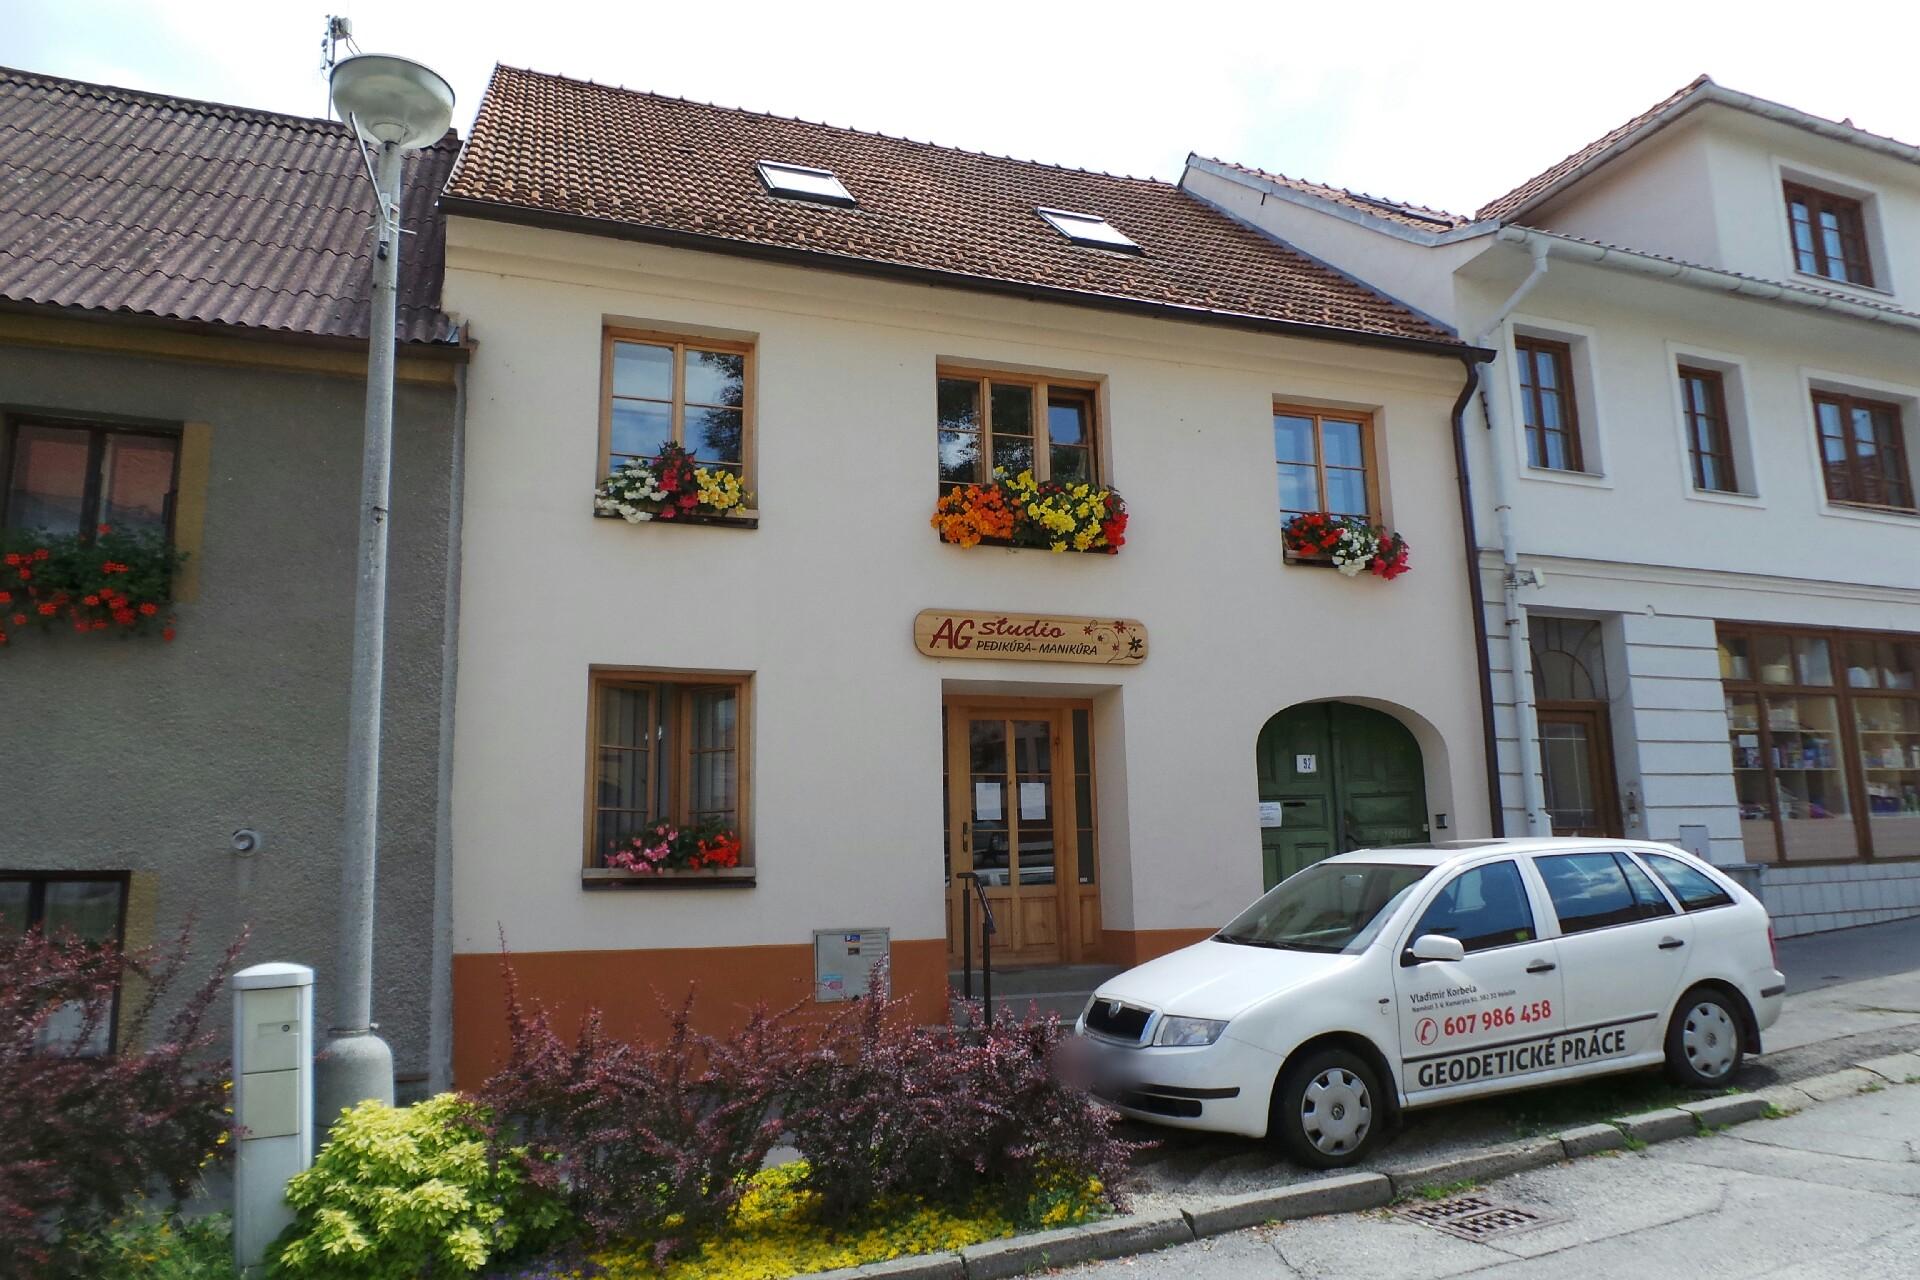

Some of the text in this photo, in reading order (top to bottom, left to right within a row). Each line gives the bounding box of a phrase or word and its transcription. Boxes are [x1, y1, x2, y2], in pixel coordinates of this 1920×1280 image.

[930, 618, 974, 650] AG
[1039, 641, 1098, 656] MANIKÚRA
[1444, 1000, 1552, 1037] 607 986 458
[1418, 1028, 1625, 1087] GEODETICKÉ PRÁCE
